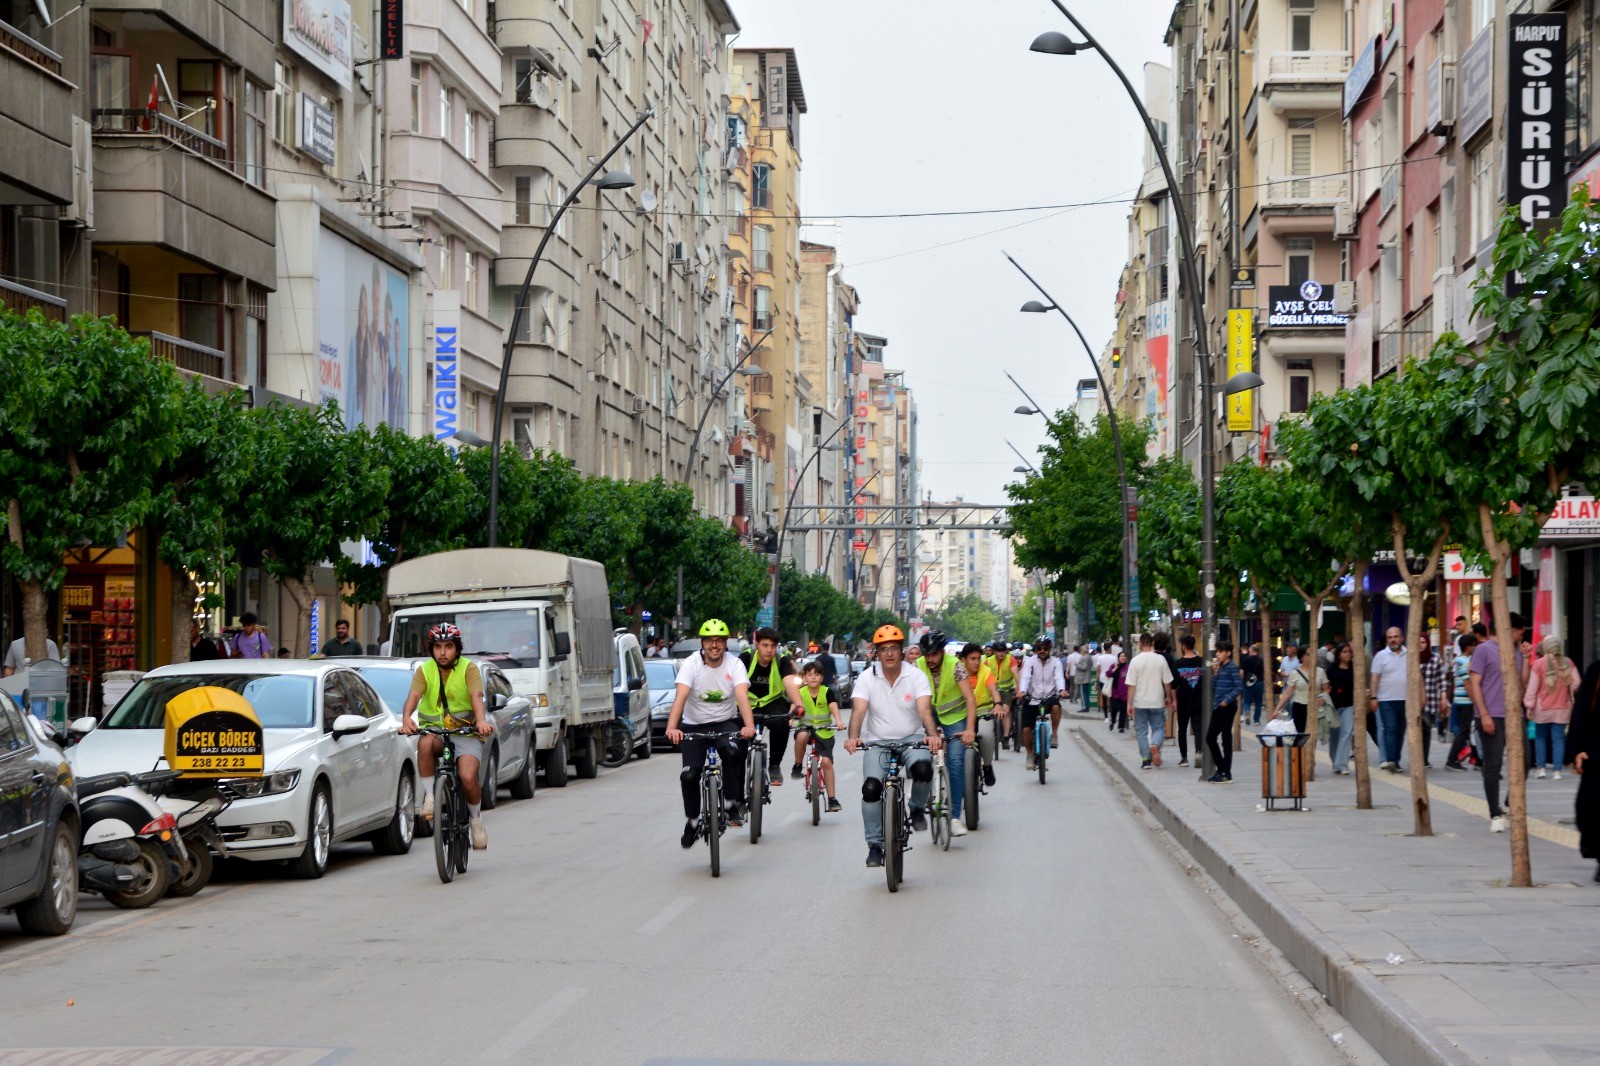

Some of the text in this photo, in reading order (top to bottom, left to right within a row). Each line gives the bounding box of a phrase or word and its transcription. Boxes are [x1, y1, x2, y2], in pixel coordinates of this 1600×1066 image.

[1515, 25, 1561, 42] HARPUT
[1274, 300, 1305, 314] AYŞE
[1269, 313, 1313, 325] GÜZELLİK
[857, 390, 869, 465] HOTEL
[182, 729, 256, 750] ÇİÇEK BÖREK
[221, 746, 256, 754] CADDESİ
[192, 758, 246, 768] 238 22 23
